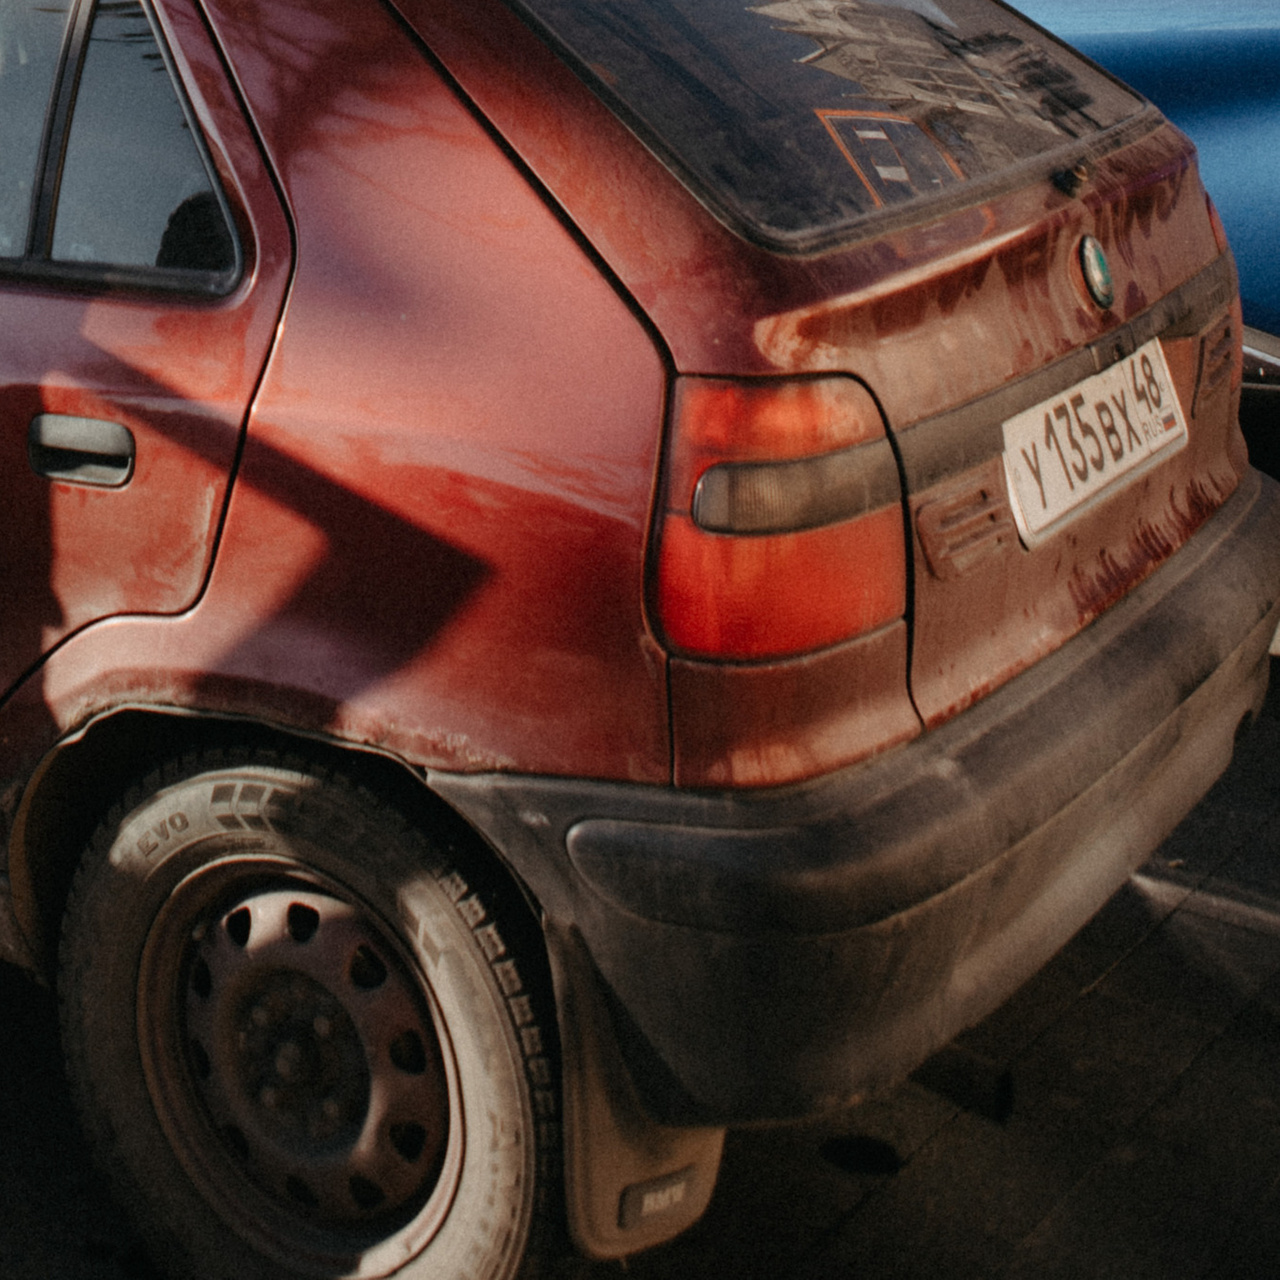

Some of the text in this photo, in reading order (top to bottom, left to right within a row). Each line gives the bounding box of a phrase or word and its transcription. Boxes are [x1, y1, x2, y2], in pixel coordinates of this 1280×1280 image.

[1130, 352, 1162, 414] 48
[1141, 414, 1164, 441] RUS
[137, 812, 189, 857] EVO
